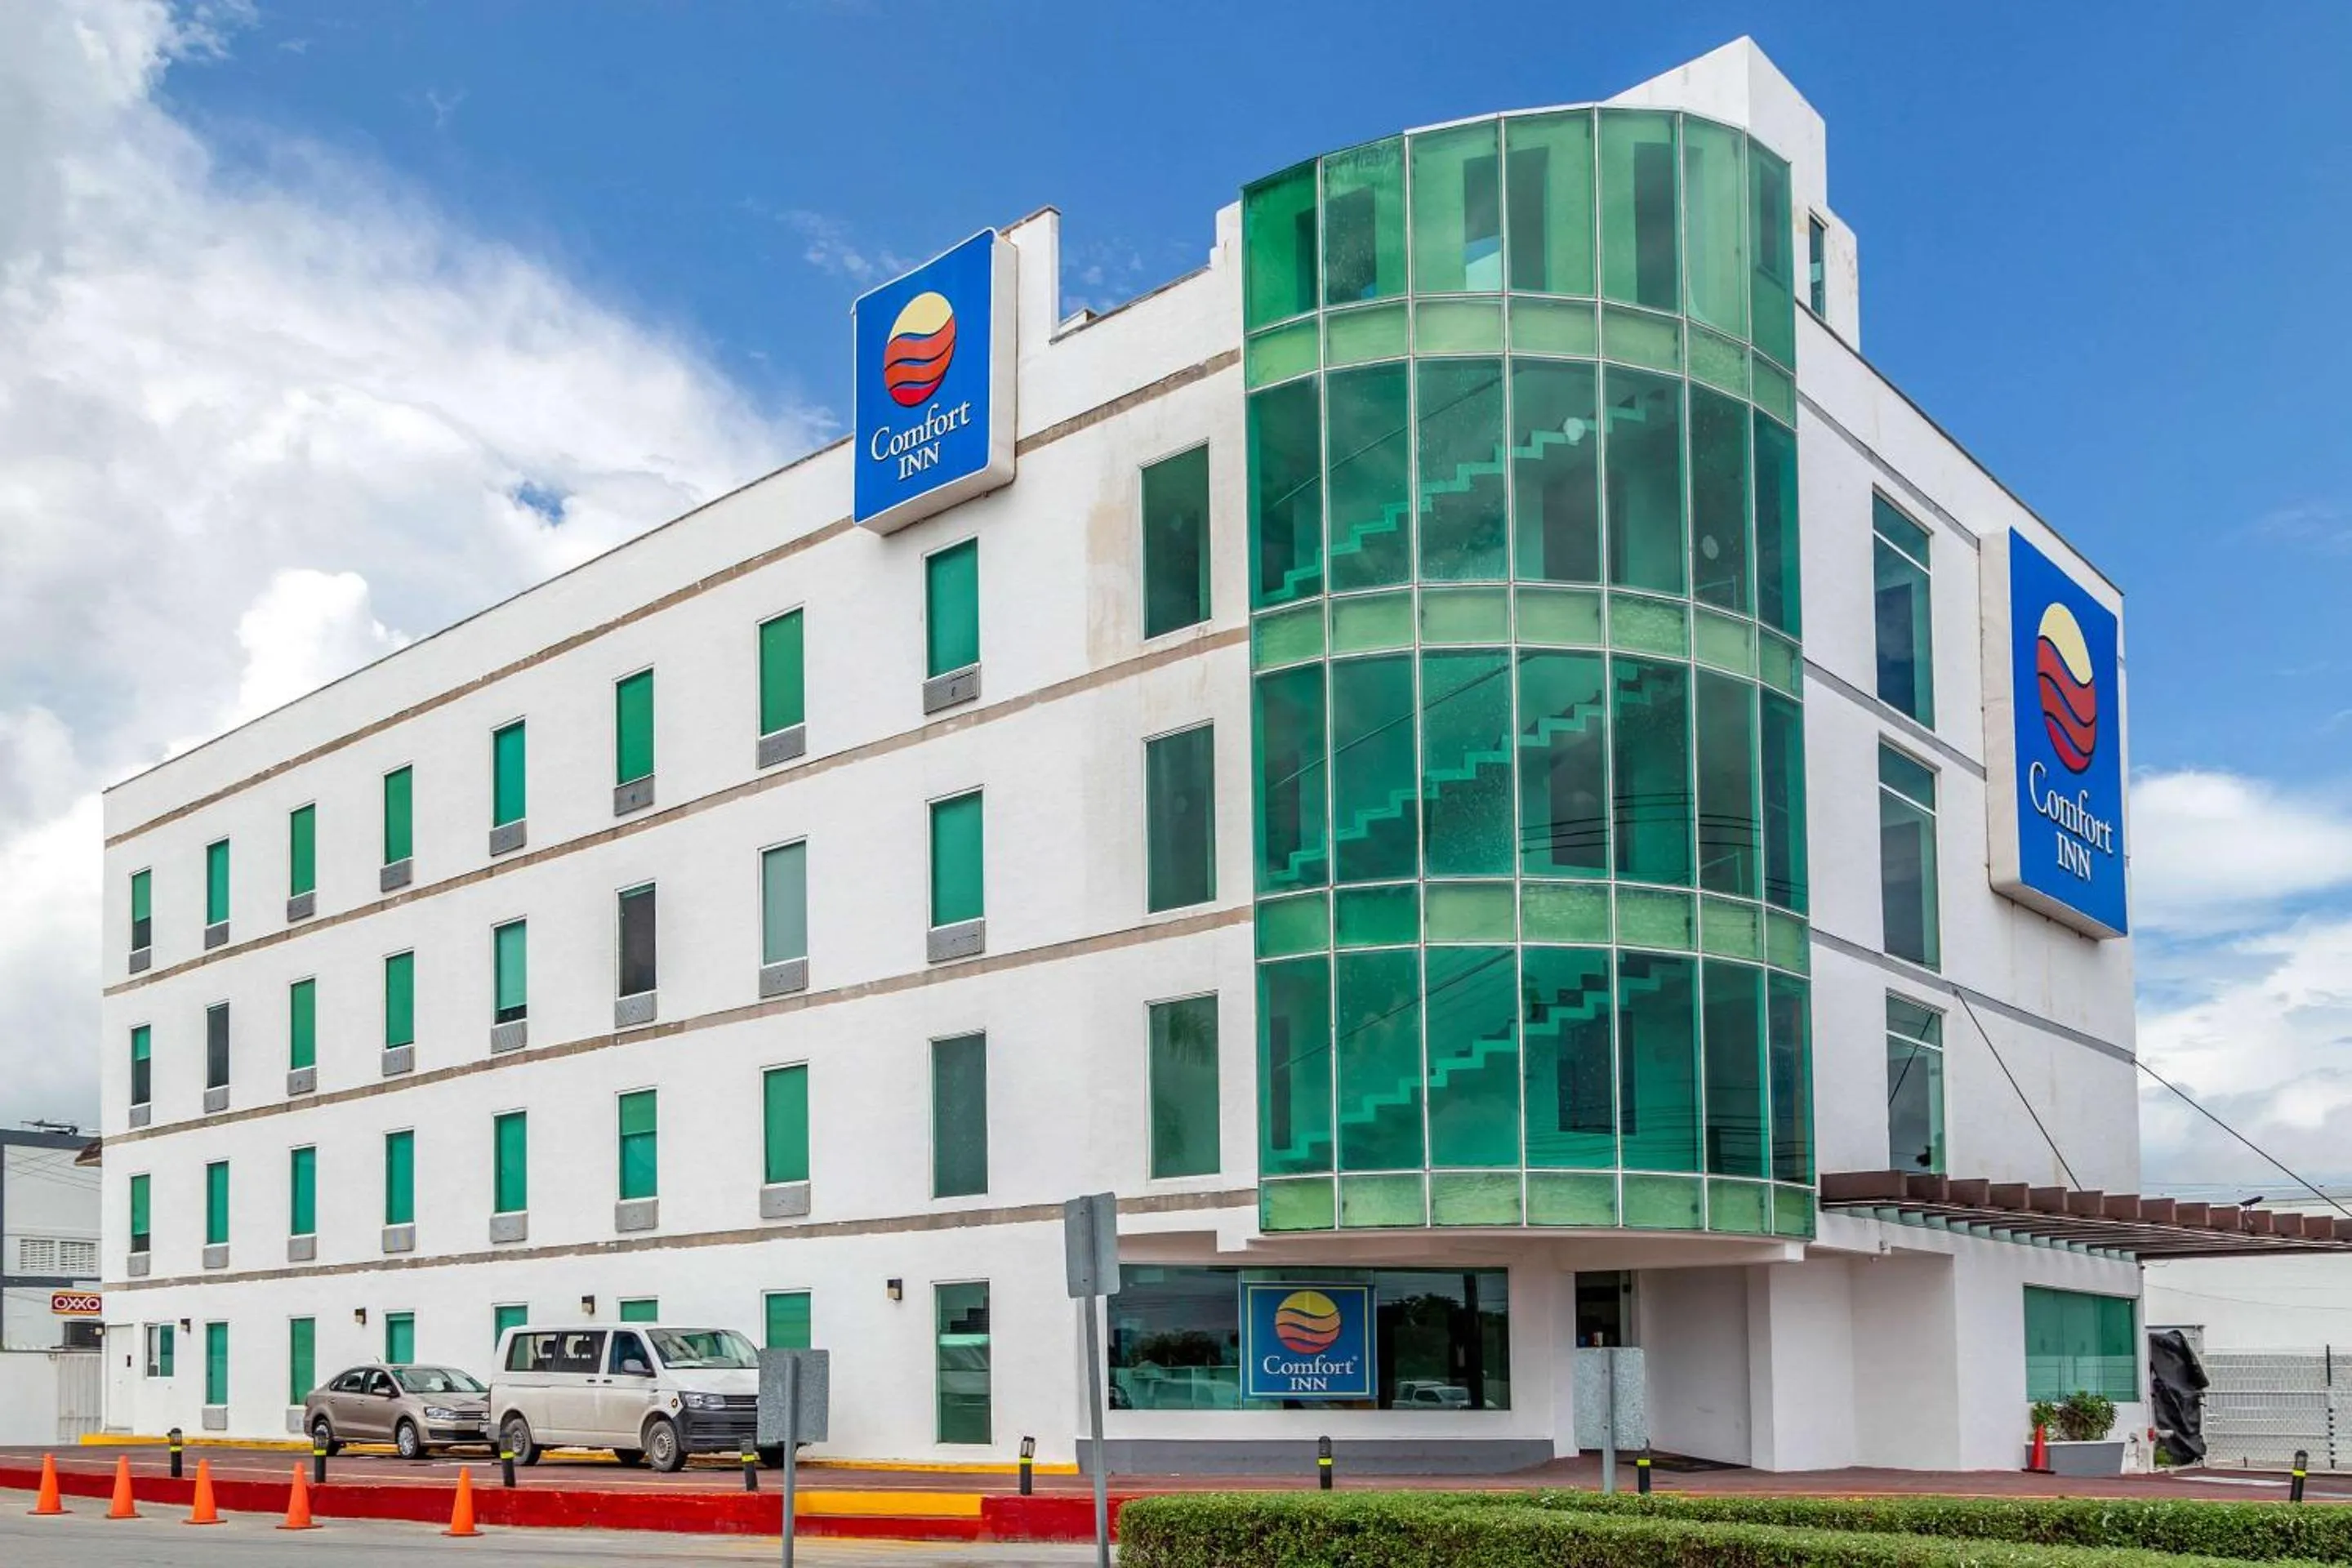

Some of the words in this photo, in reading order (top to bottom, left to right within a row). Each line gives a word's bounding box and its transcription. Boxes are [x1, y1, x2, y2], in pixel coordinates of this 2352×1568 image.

[871, 402, 972, 461] Comfort
[898, 441, 940, 481] INN
[2029, 760, 2114, 854] Comfort
[2056, 831, 2091, 882] INN
[54, 1296, 100, 1311] OXXO
[1263, 1354, 1355, 1375] Comfort
[1290, 1377, 1328, 1391] INN
